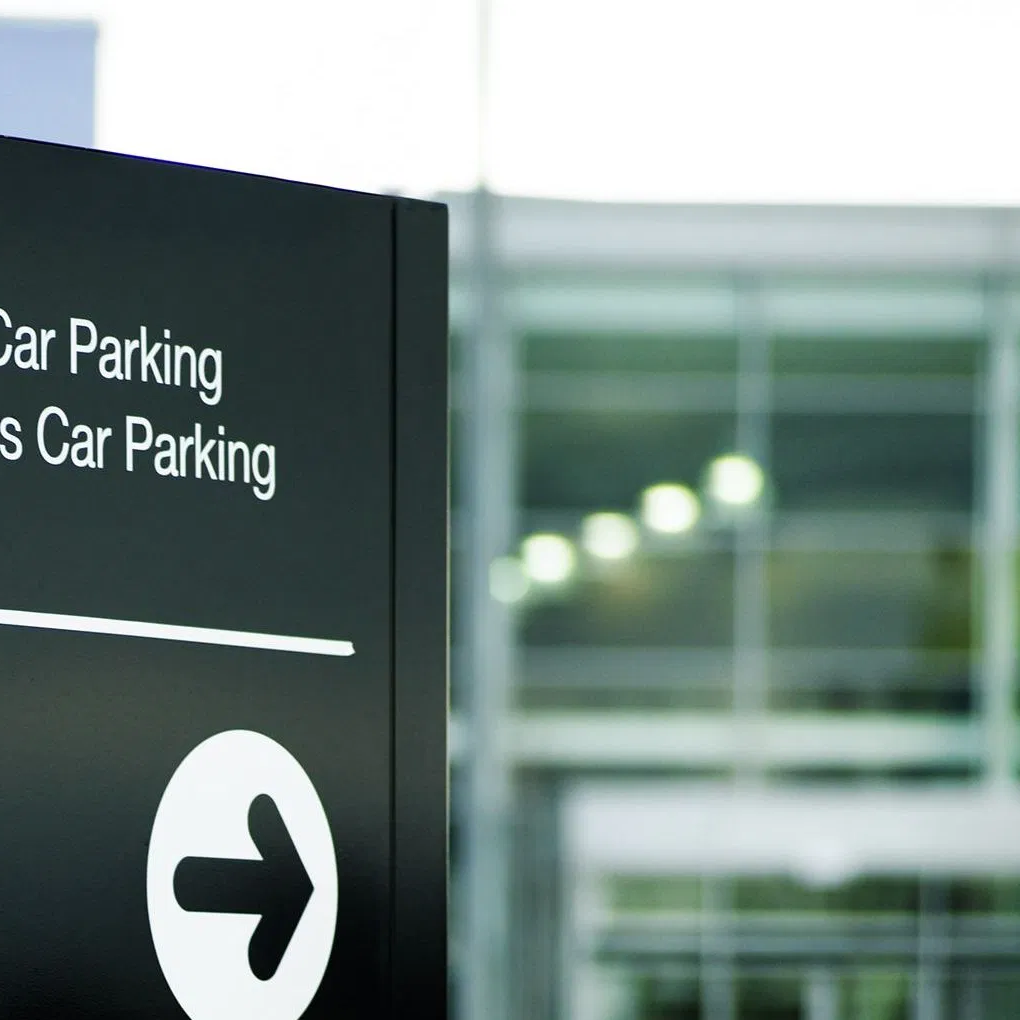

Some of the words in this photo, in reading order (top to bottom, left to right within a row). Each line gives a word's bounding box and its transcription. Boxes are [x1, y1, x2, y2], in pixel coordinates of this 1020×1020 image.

[69, 317, 223, 406] Parking
[36, 405, 113, 469] Car
[125, 415, 276, 501] Parking
